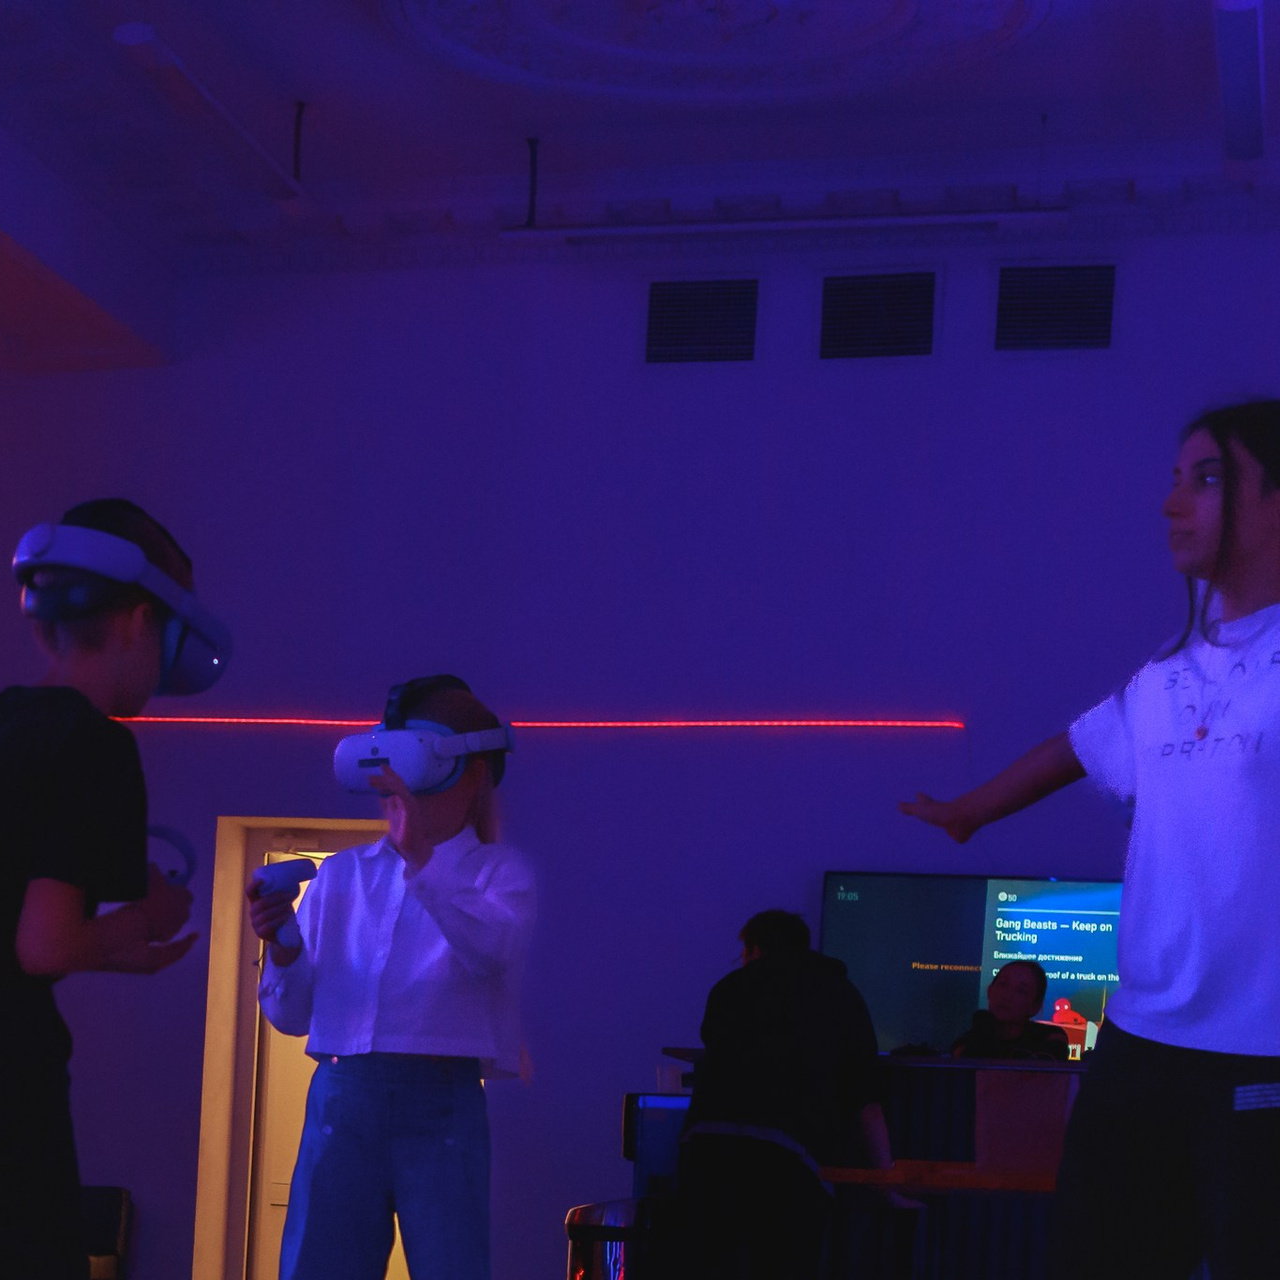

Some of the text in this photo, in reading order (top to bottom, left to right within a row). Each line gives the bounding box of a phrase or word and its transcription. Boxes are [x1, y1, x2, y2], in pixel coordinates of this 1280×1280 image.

[996, 918, 1021, 930] Gang
[1023, 919, 1058, 930] Beasts
[1072, 920, 1097, 933] Keep
[1100, 923, 1113, 932] on
[995, 931, 1037, 944] Trucking
[1038, 954, 1083, 963] достижение
[912, 962, 939, 971] Please
[1061, 971, 1070, 980] of
[1070, 973, 1076, 981] a
[1077, 972, 1096, 981] truck
[1097, 974, 1107, 982] on
[1108, 973, 1120, 982] the
